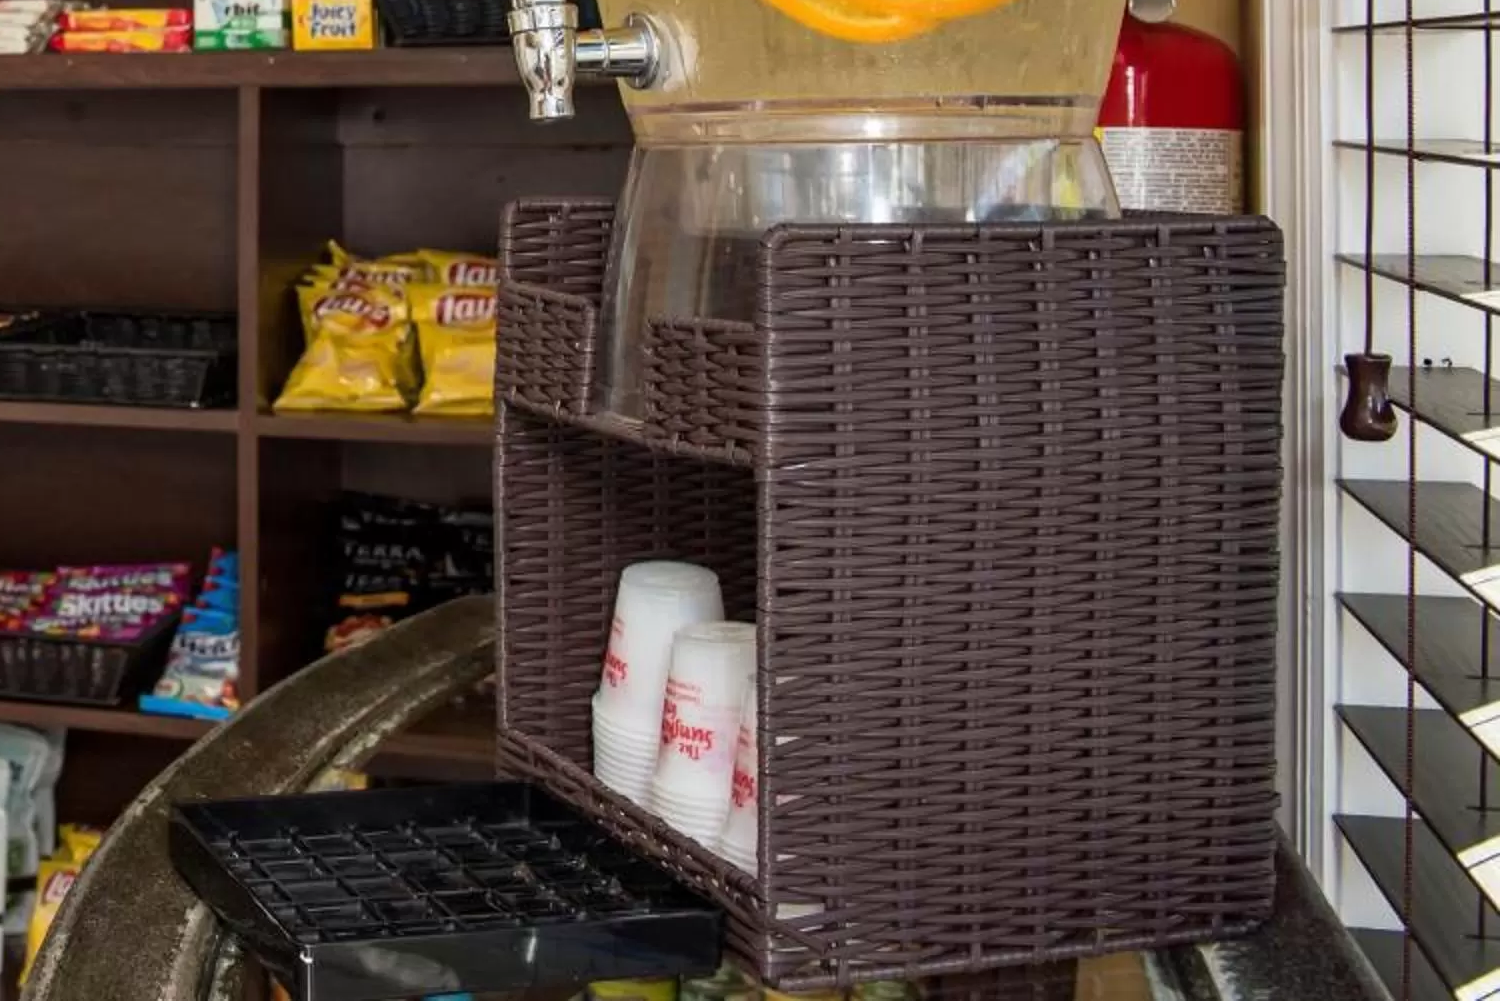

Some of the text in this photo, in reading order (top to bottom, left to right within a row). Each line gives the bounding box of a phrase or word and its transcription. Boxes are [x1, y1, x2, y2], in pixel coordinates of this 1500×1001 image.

[310, 3, 357, 21] Juicy
[310, 20, 357, 39] Fruit
[56, 593, 163, 617] Skittles
